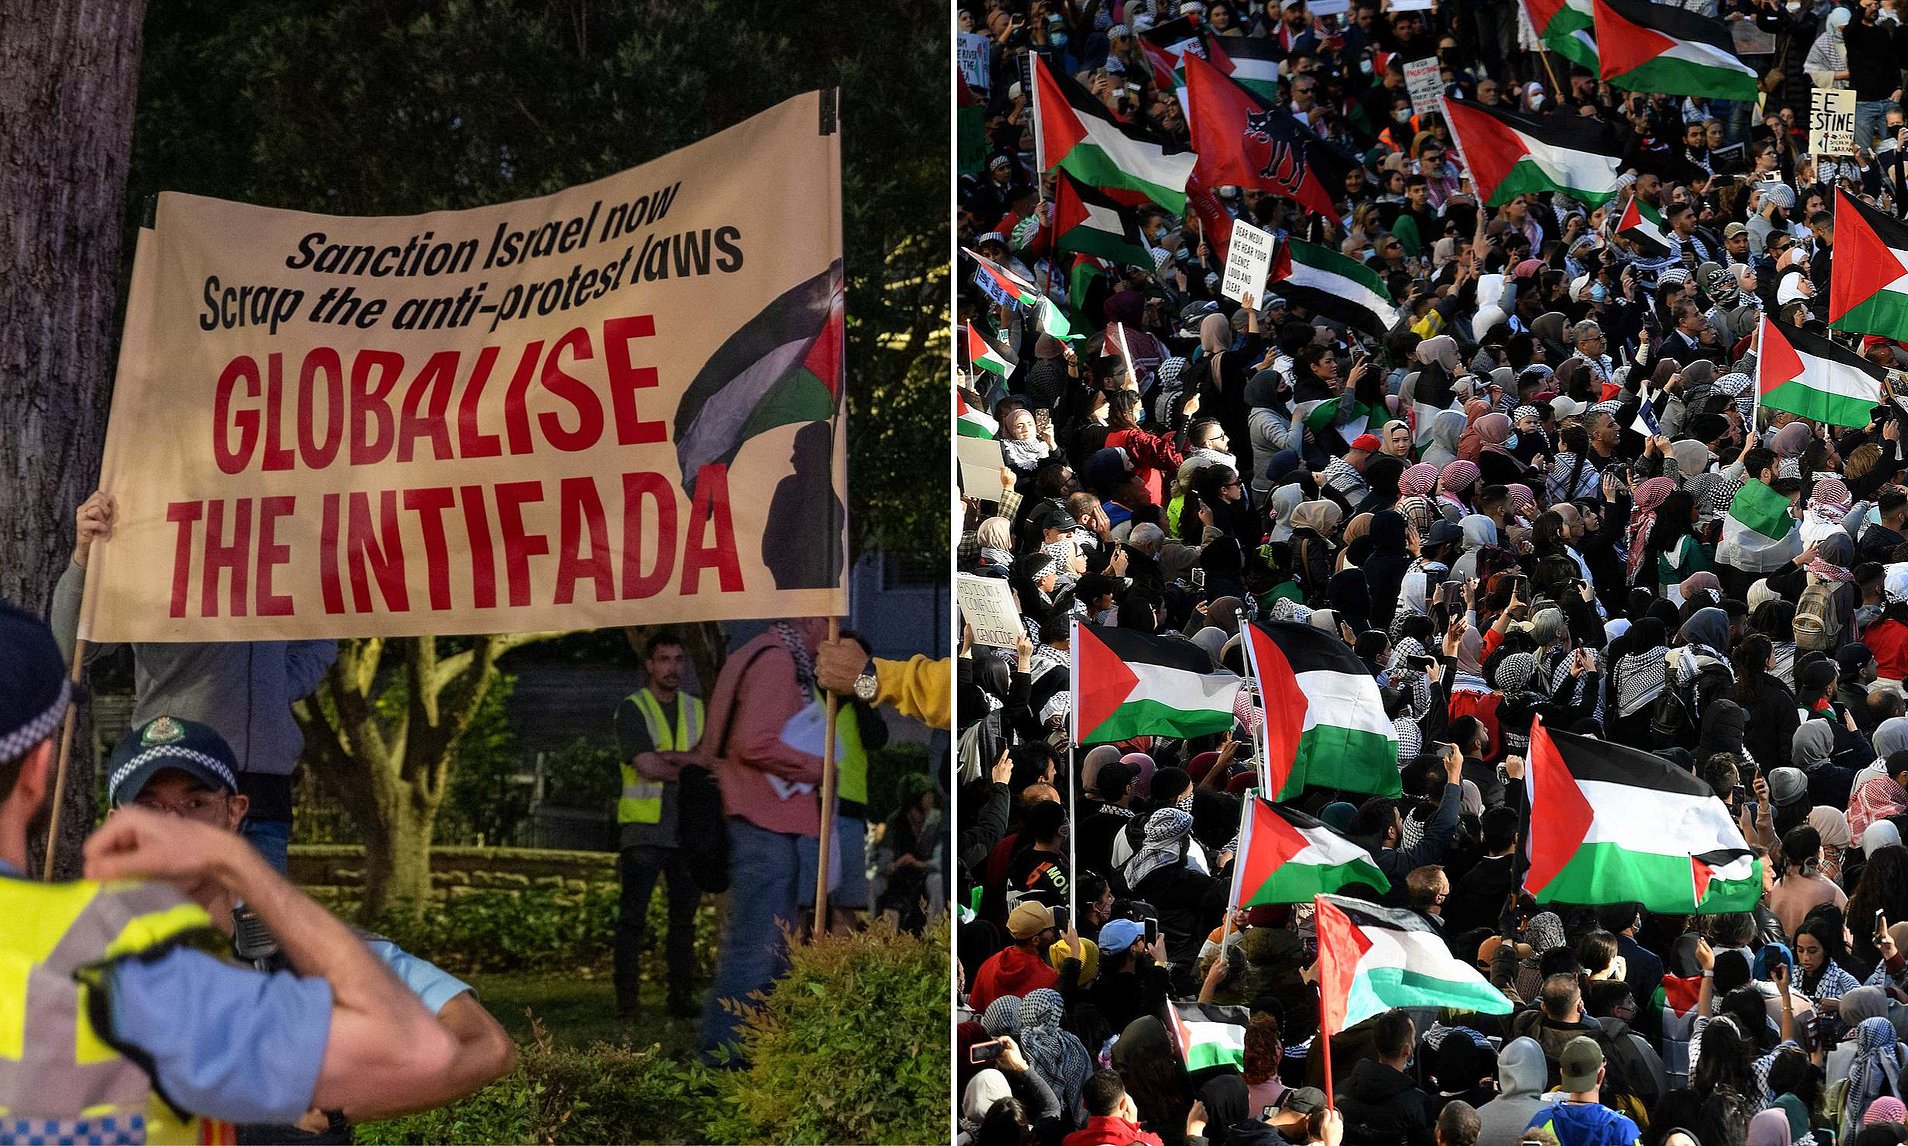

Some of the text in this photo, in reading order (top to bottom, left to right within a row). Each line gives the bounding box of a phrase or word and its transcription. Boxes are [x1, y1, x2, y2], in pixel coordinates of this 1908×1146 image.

[286, 180, 682, 277] Sanction Israel now
[1235, 225, 1264, 246] DEAR MEDIA
[1233, 240, 1267, 262] WE HEAR YOUR
[1230, 253, 1250, 270] SILENCE
[200, 224, 744, 335] Scrap the anti-protest laws
[1228, 266, 1252, 285] LOUD AND
[1225, 280, 1241, 294] CLEAR
[213, 314, 668, 475] GLOBALISE
[166, 463, 745, 618] THE INTIFADA
[972, 583, 985, 596] IS
[976, 613, 1005, 629] IT IS
[976, 628, 1016, 645] GENOCIDE
